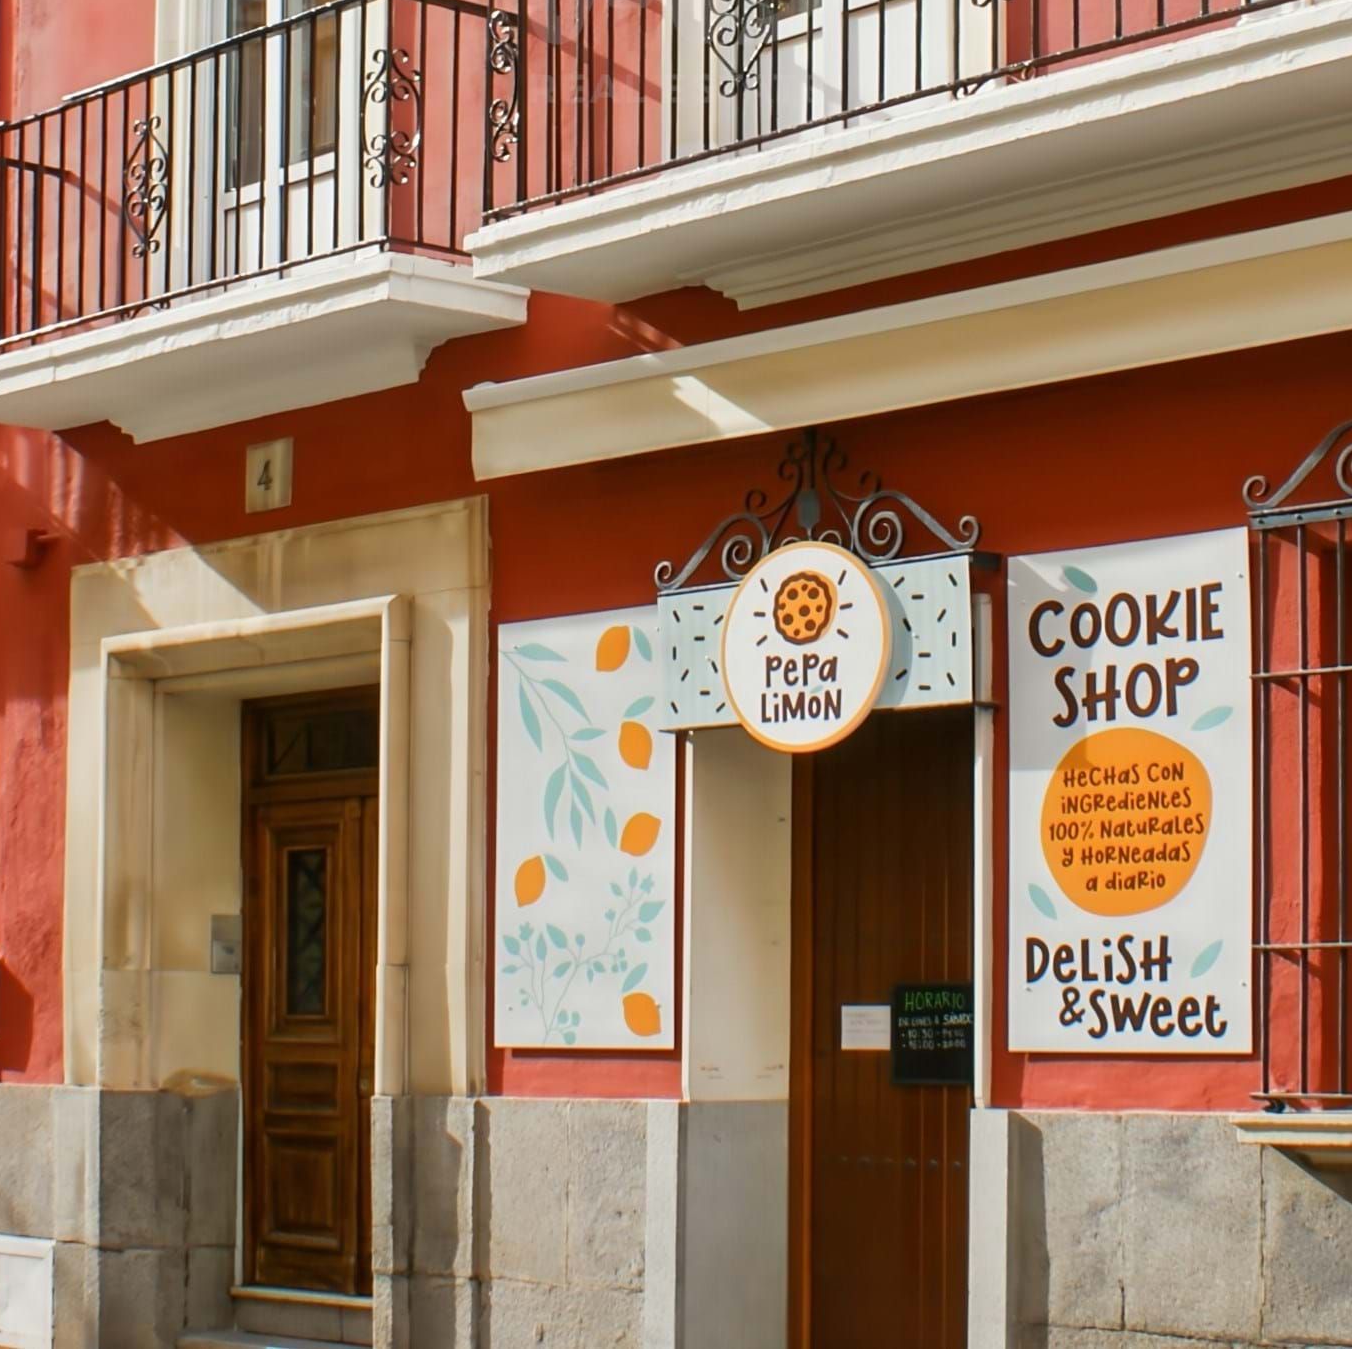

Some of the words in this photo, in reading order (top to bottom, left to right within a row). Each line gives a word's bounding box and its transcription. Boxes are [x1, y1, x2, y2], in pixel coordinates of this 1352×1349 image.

[257, 459, 273, 491] 4
[1029, 582, 1224, 658] COOKIE
[1052, 658, 1200, 729] SHOP
[1049, 819, 1094, 841] 100%
[1086, 876, 1098, 891] a
[904, 991, 965, 1011] HORARIO
